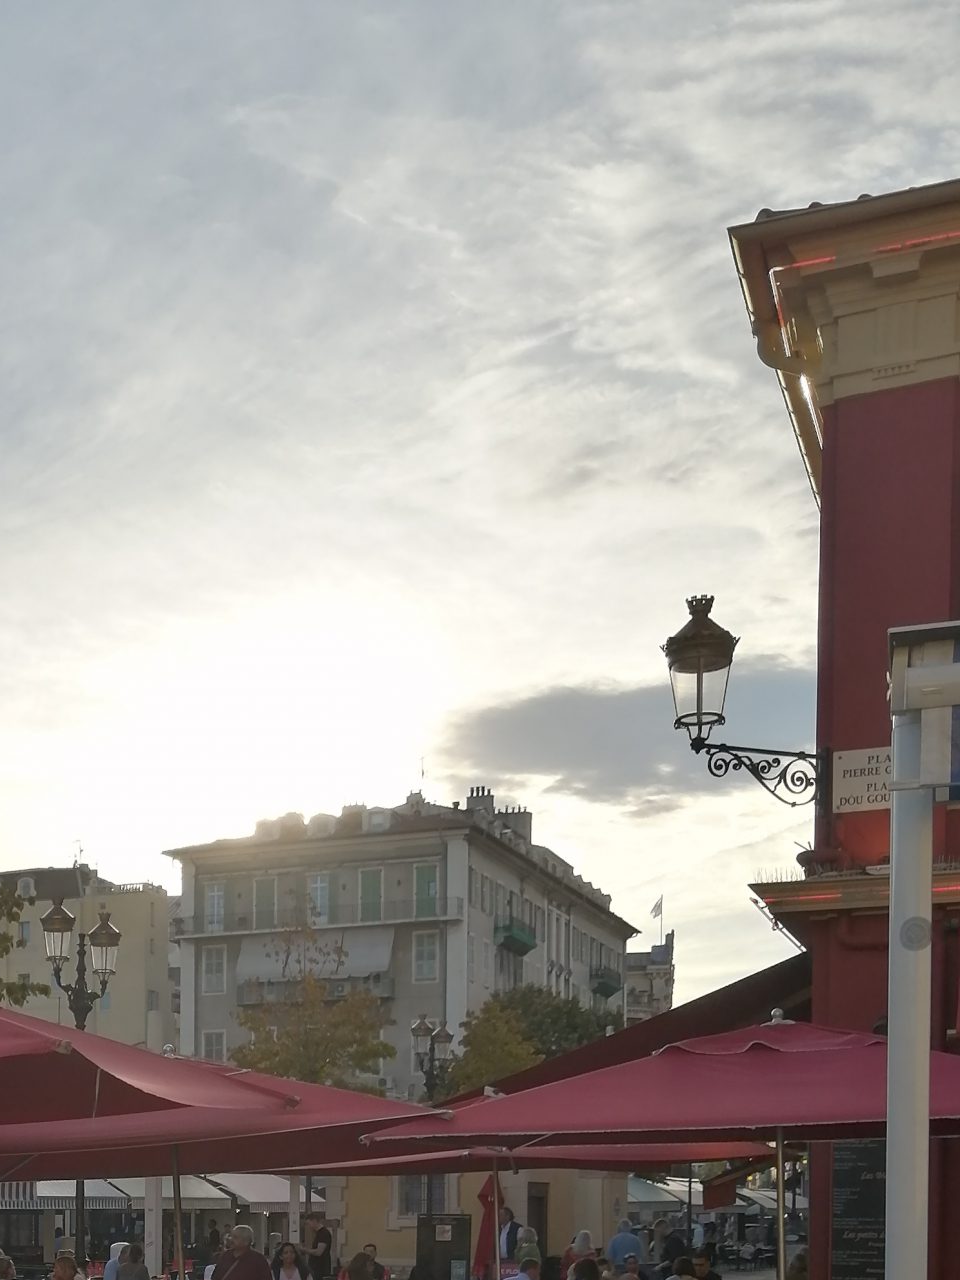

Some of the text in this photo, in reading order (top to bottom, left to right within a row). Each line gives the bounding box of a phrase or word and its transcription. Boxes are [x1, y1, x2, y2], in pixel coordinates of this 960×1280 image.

[867, 754, 891, 765] PLA
[843, 767, 881, 778] PIERRE
[866, 782, 887, 792] PLA
[867, 793, 891, 804] GOU
